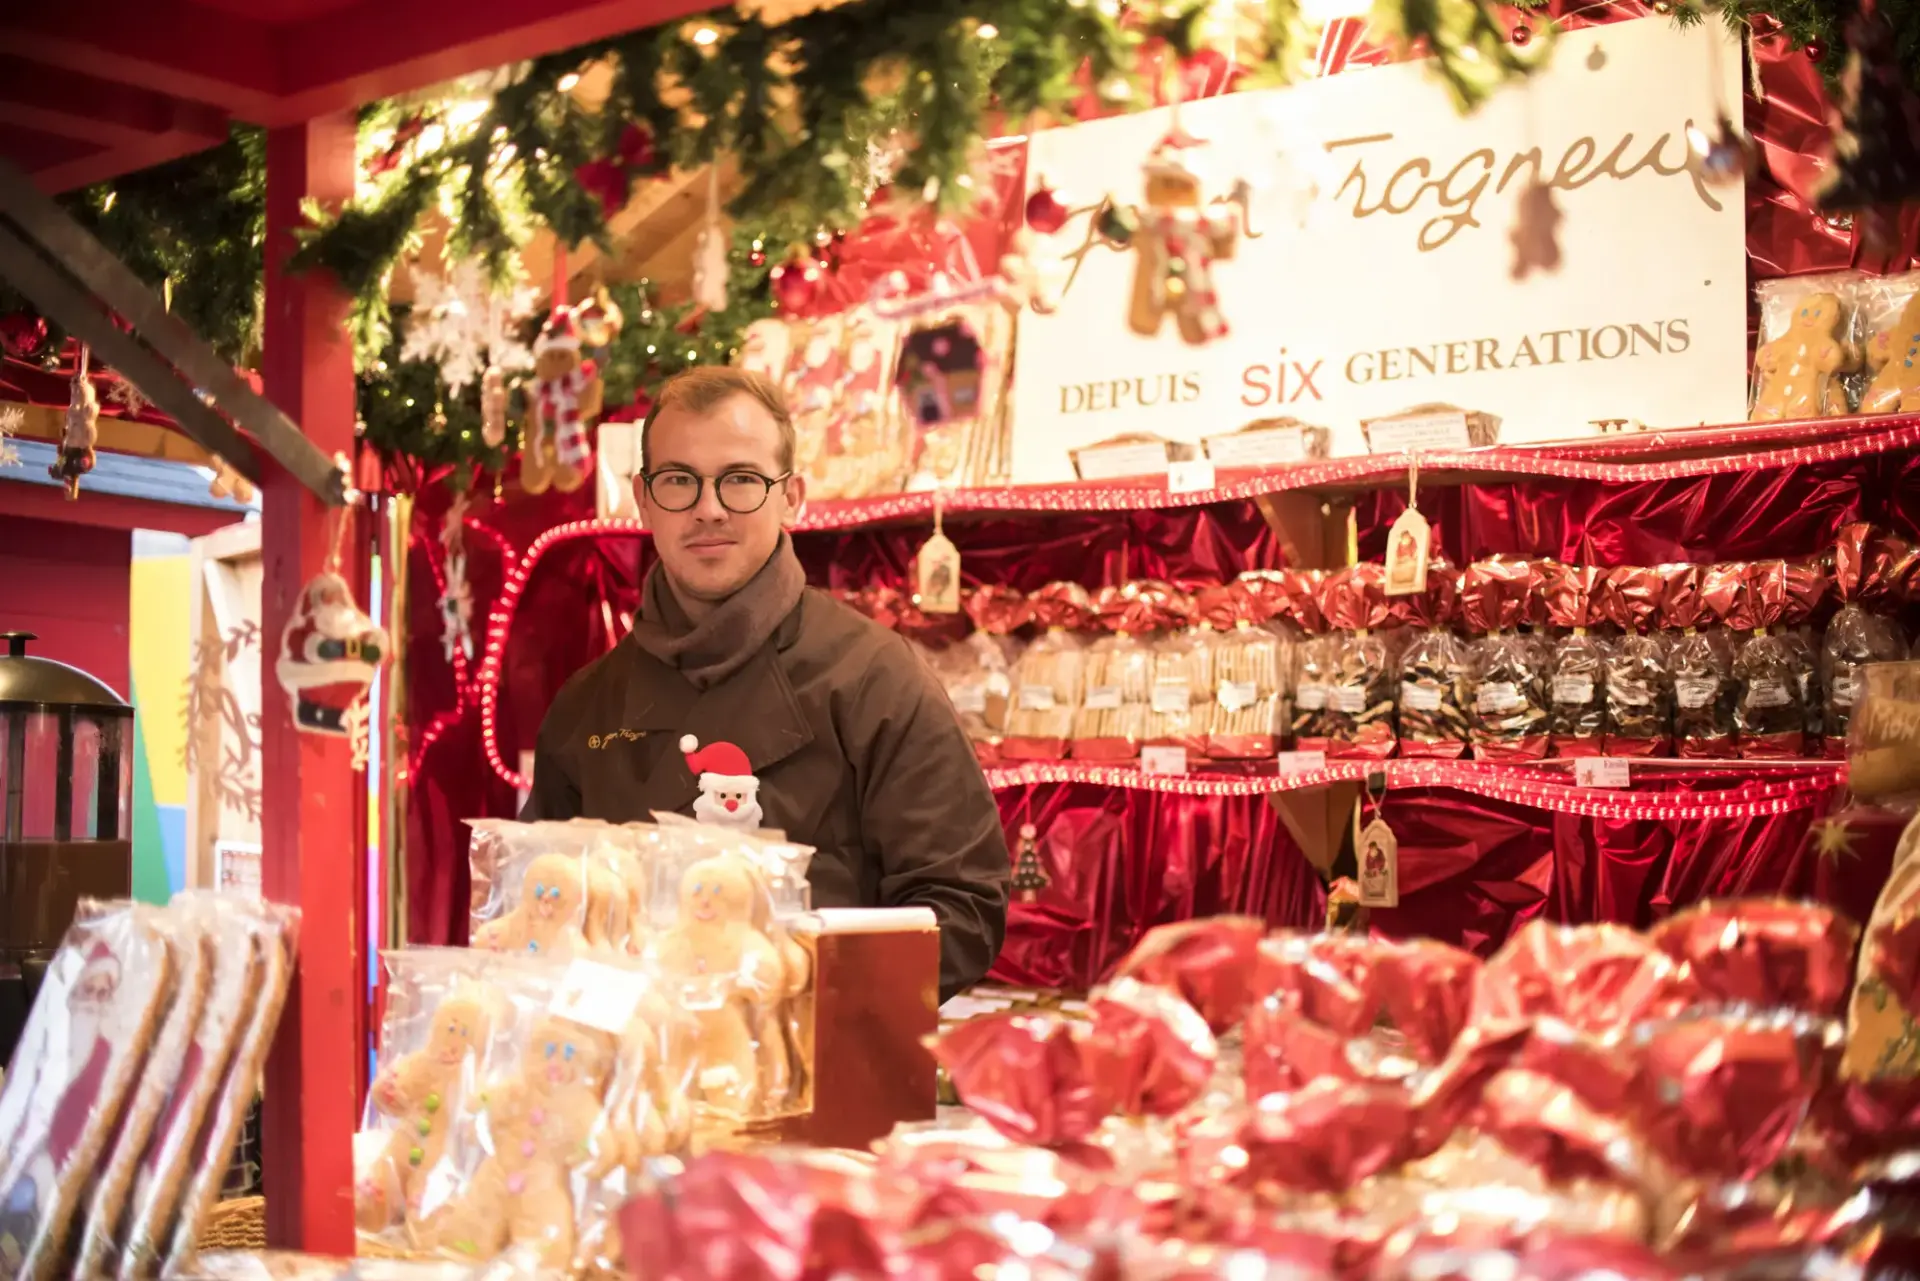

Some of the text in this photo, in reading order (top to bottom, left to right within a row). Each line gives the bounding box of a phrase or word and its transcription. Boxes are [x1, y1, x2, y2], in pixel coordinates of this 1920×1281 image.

[1059, 318, 1691, 415] DEPUIS six GENERATIONS
